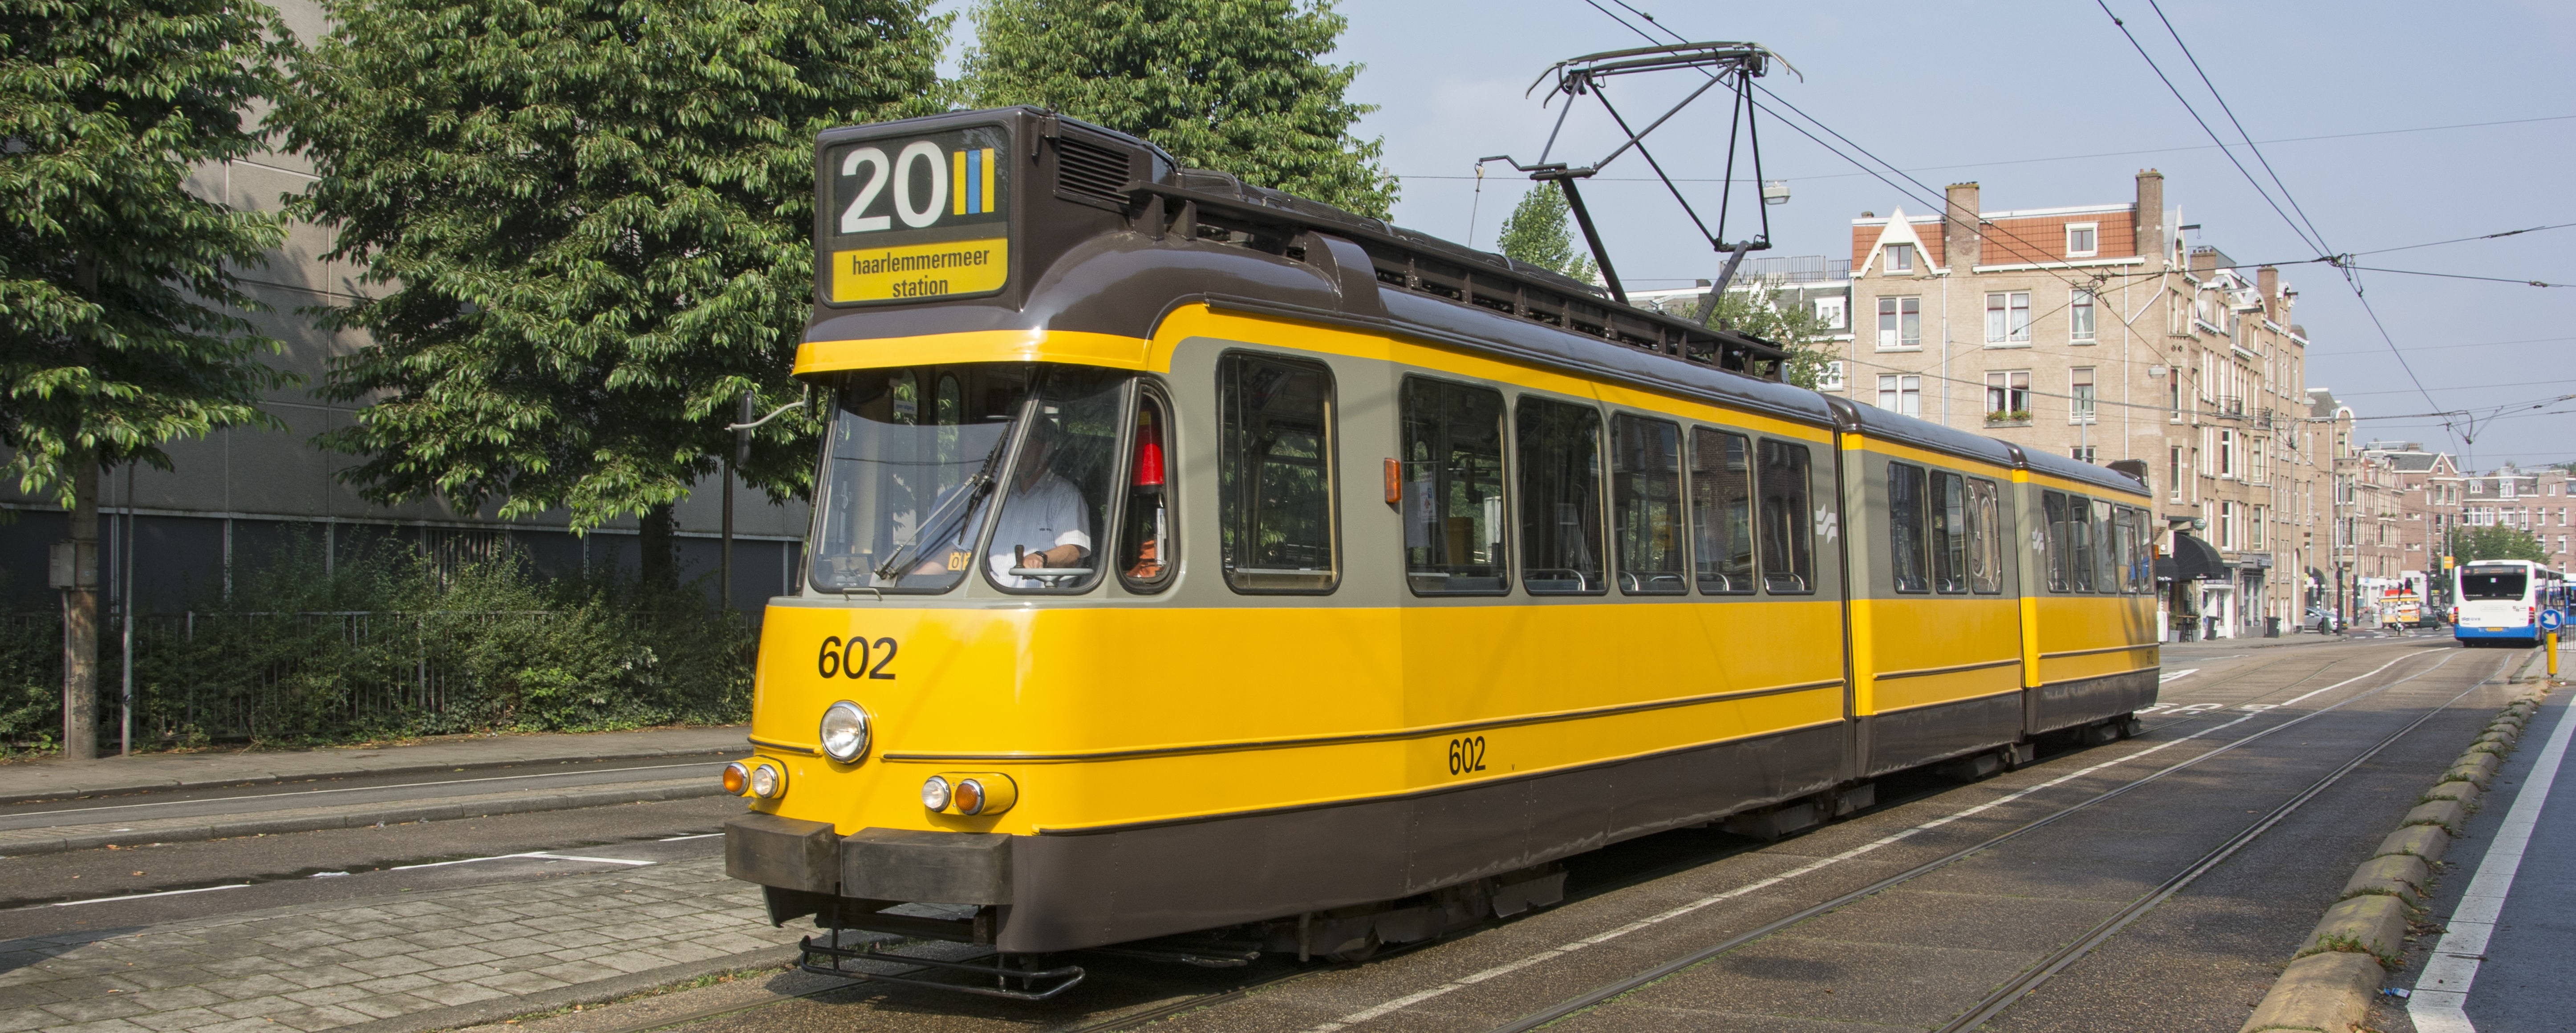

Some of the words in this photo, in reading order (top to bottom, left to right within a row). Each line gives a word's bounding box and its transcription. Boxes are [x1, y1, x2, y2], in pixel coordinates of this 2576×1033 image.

[841, 141, 948, 233] 20
[852, 250, 990, 275] haarlemmermeer
[893, 275, 948, 297] station
[818, 636, 897, 680] 602
[1449, 736, 1486, 776] 602
